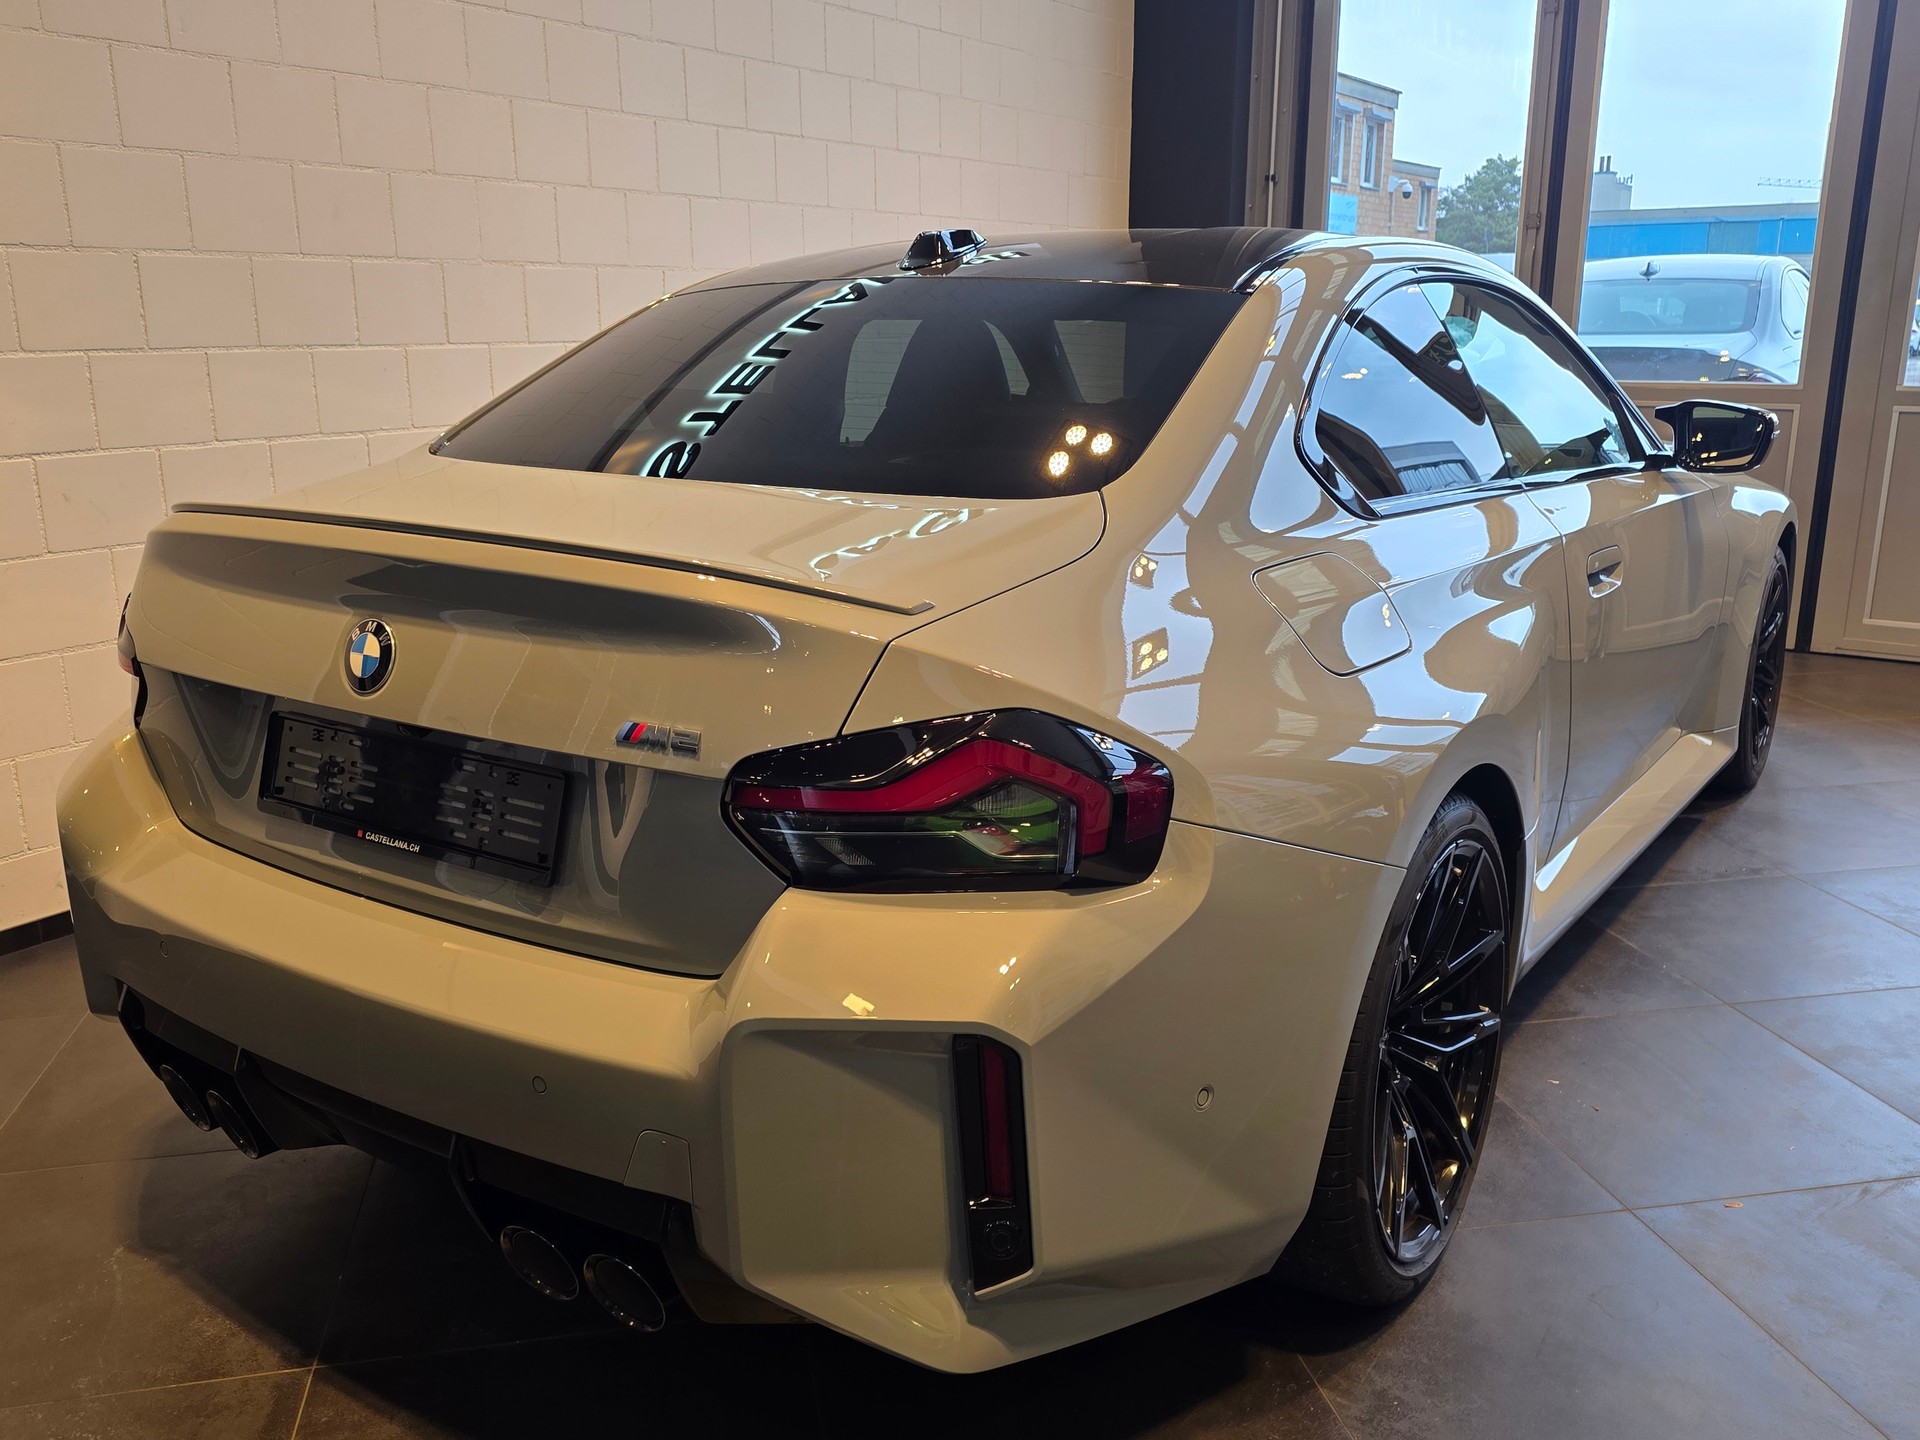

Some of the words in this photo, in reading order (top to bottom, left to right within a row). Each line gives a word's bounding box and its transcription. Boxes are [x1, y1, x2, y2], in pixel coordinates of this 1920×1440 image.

[352, 621, 391, 646] BMW
[620, 721, 701, 754] M2
[365, 831, 420, 852] CASTELLANA.CH
